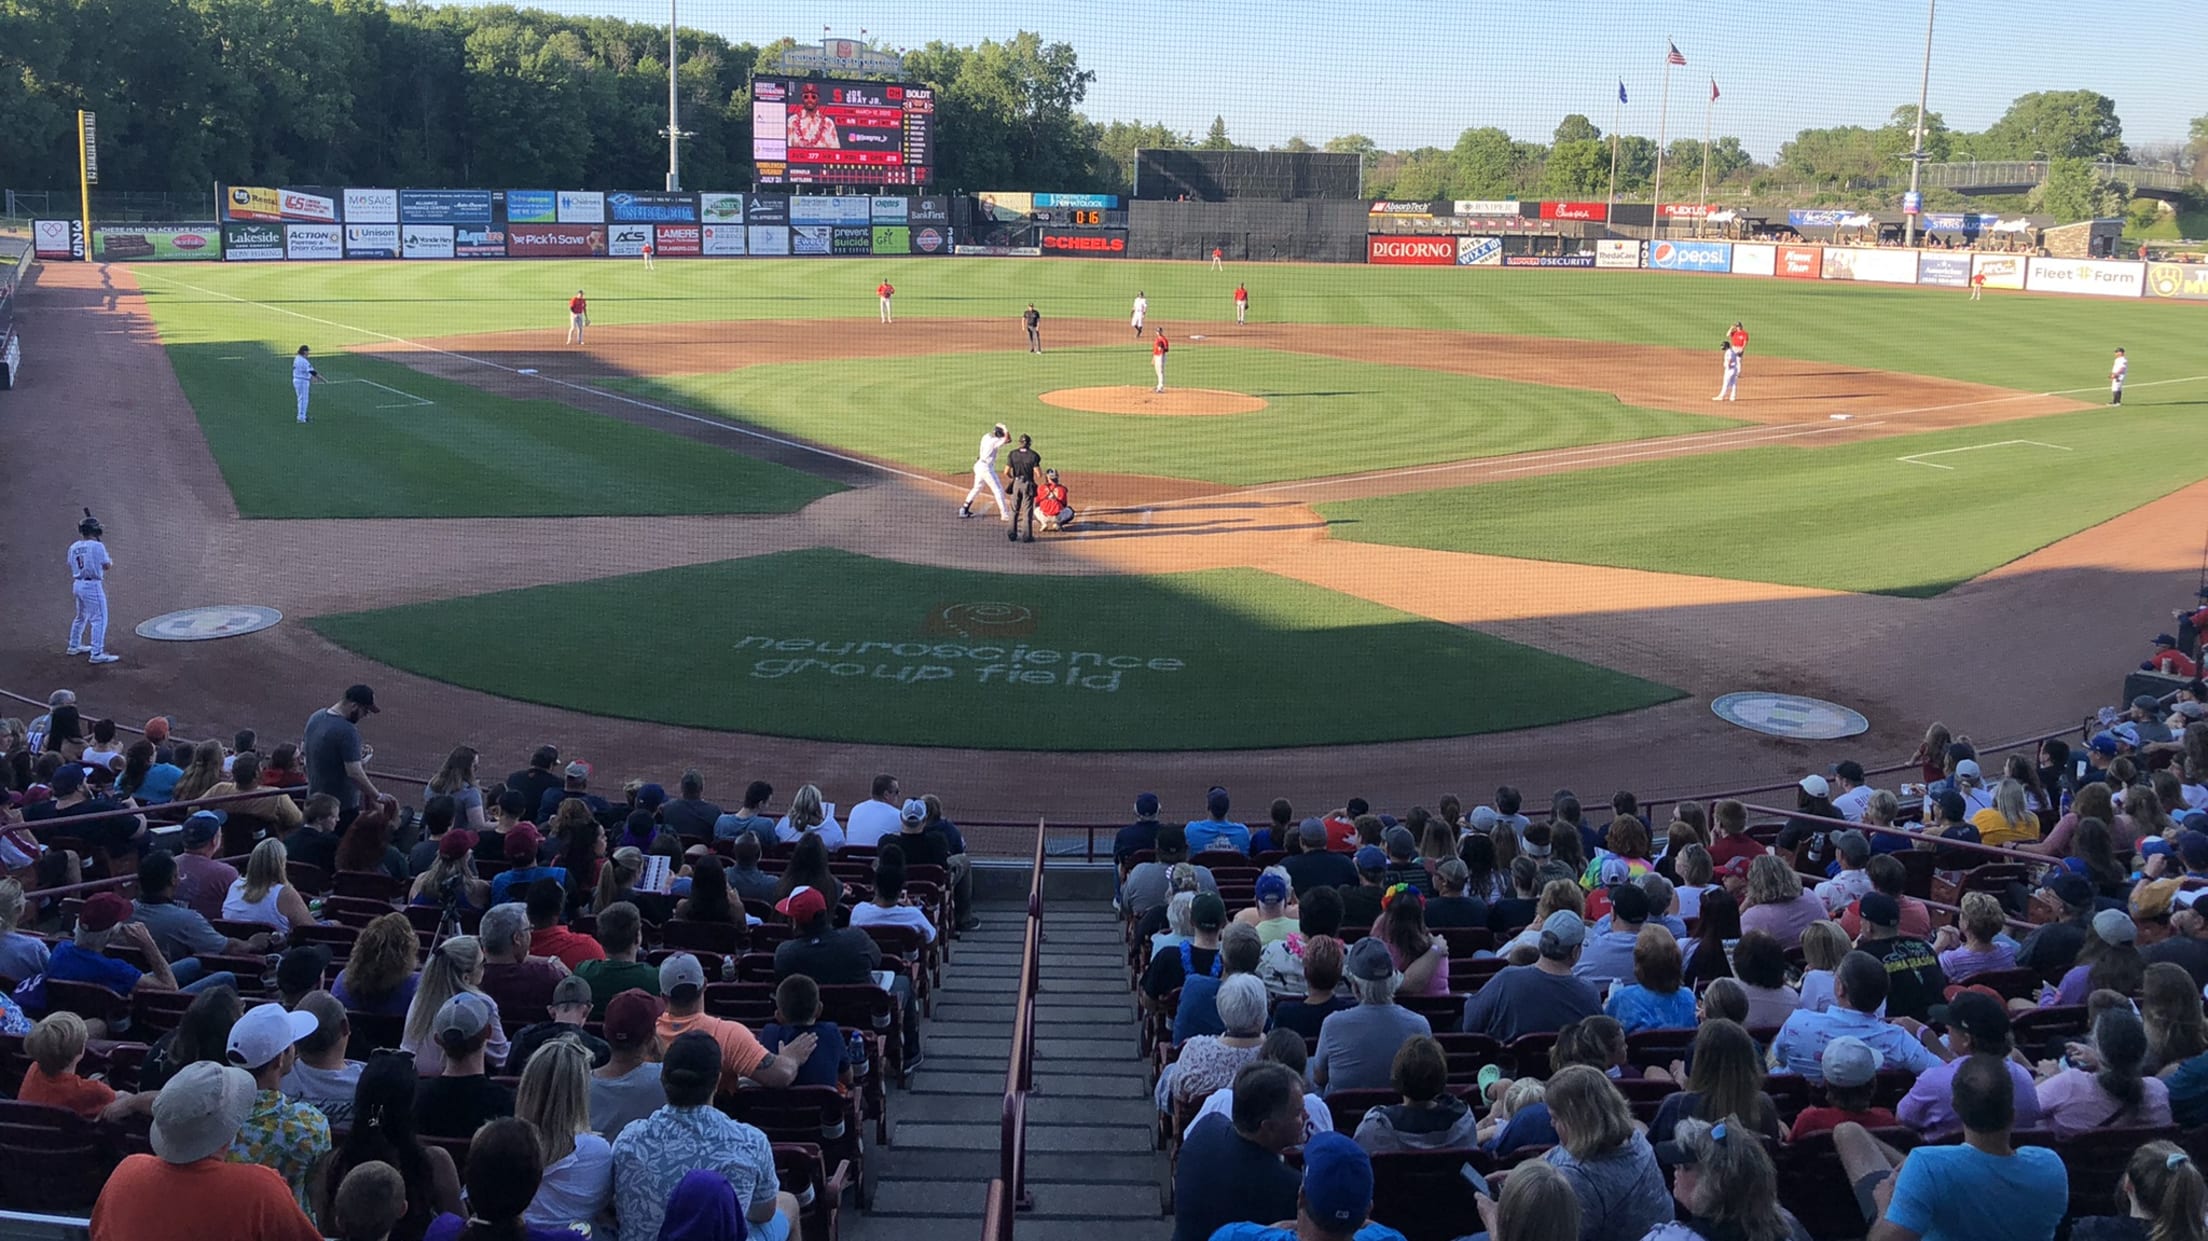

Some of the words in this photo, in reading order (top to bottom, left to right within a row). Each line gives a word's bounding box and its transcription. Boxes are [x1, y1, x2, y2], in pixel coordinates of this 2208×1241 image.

[846, 89, 862, 97] JOE
[906, 90, 931, 99] BOLDT
[846, 96, 867, 104] GRAY
[252, 194, 278, 206] Rental
[875, 199, 899, 207] ORBIS
[1665, 206, 1707, 216] PLEXUS
[1933, 222, 1960, 230] STARS
[229, 232, 280, 243] Lakeside
[289, 231, 329, 239] ACTION
[361, 229, 395, 237] Unison
[615, 231, 646, 242] ACS
[657, 229, 699, 238] LAMERS
[834, 228, 869, 238] prevent
[558, 234, 584, 245] Save
[834, 237, 869, 247] suicide
[876, 235, 892, 245] GFL
[1043, 236, 1125, 251] SCHEELS
[1373, 242, 1452, 257] DIGIORNO
[1461, 239, 1482, 251] HITS
[228, 250, 250, 258] NOW
[251, 249, 281, 257] HIRING
[1458, 247, 1488, 264] WIXX
[1678, 249, 1725, 265] pepsi
[2035, 267, 2073, 280] Fleet
[2094, 270, 2135, 283] Farm
[733, 634, 1186, 673] neuroscience
[750, 657, 956, 684] group
[975, 664, 1123, 692] field
